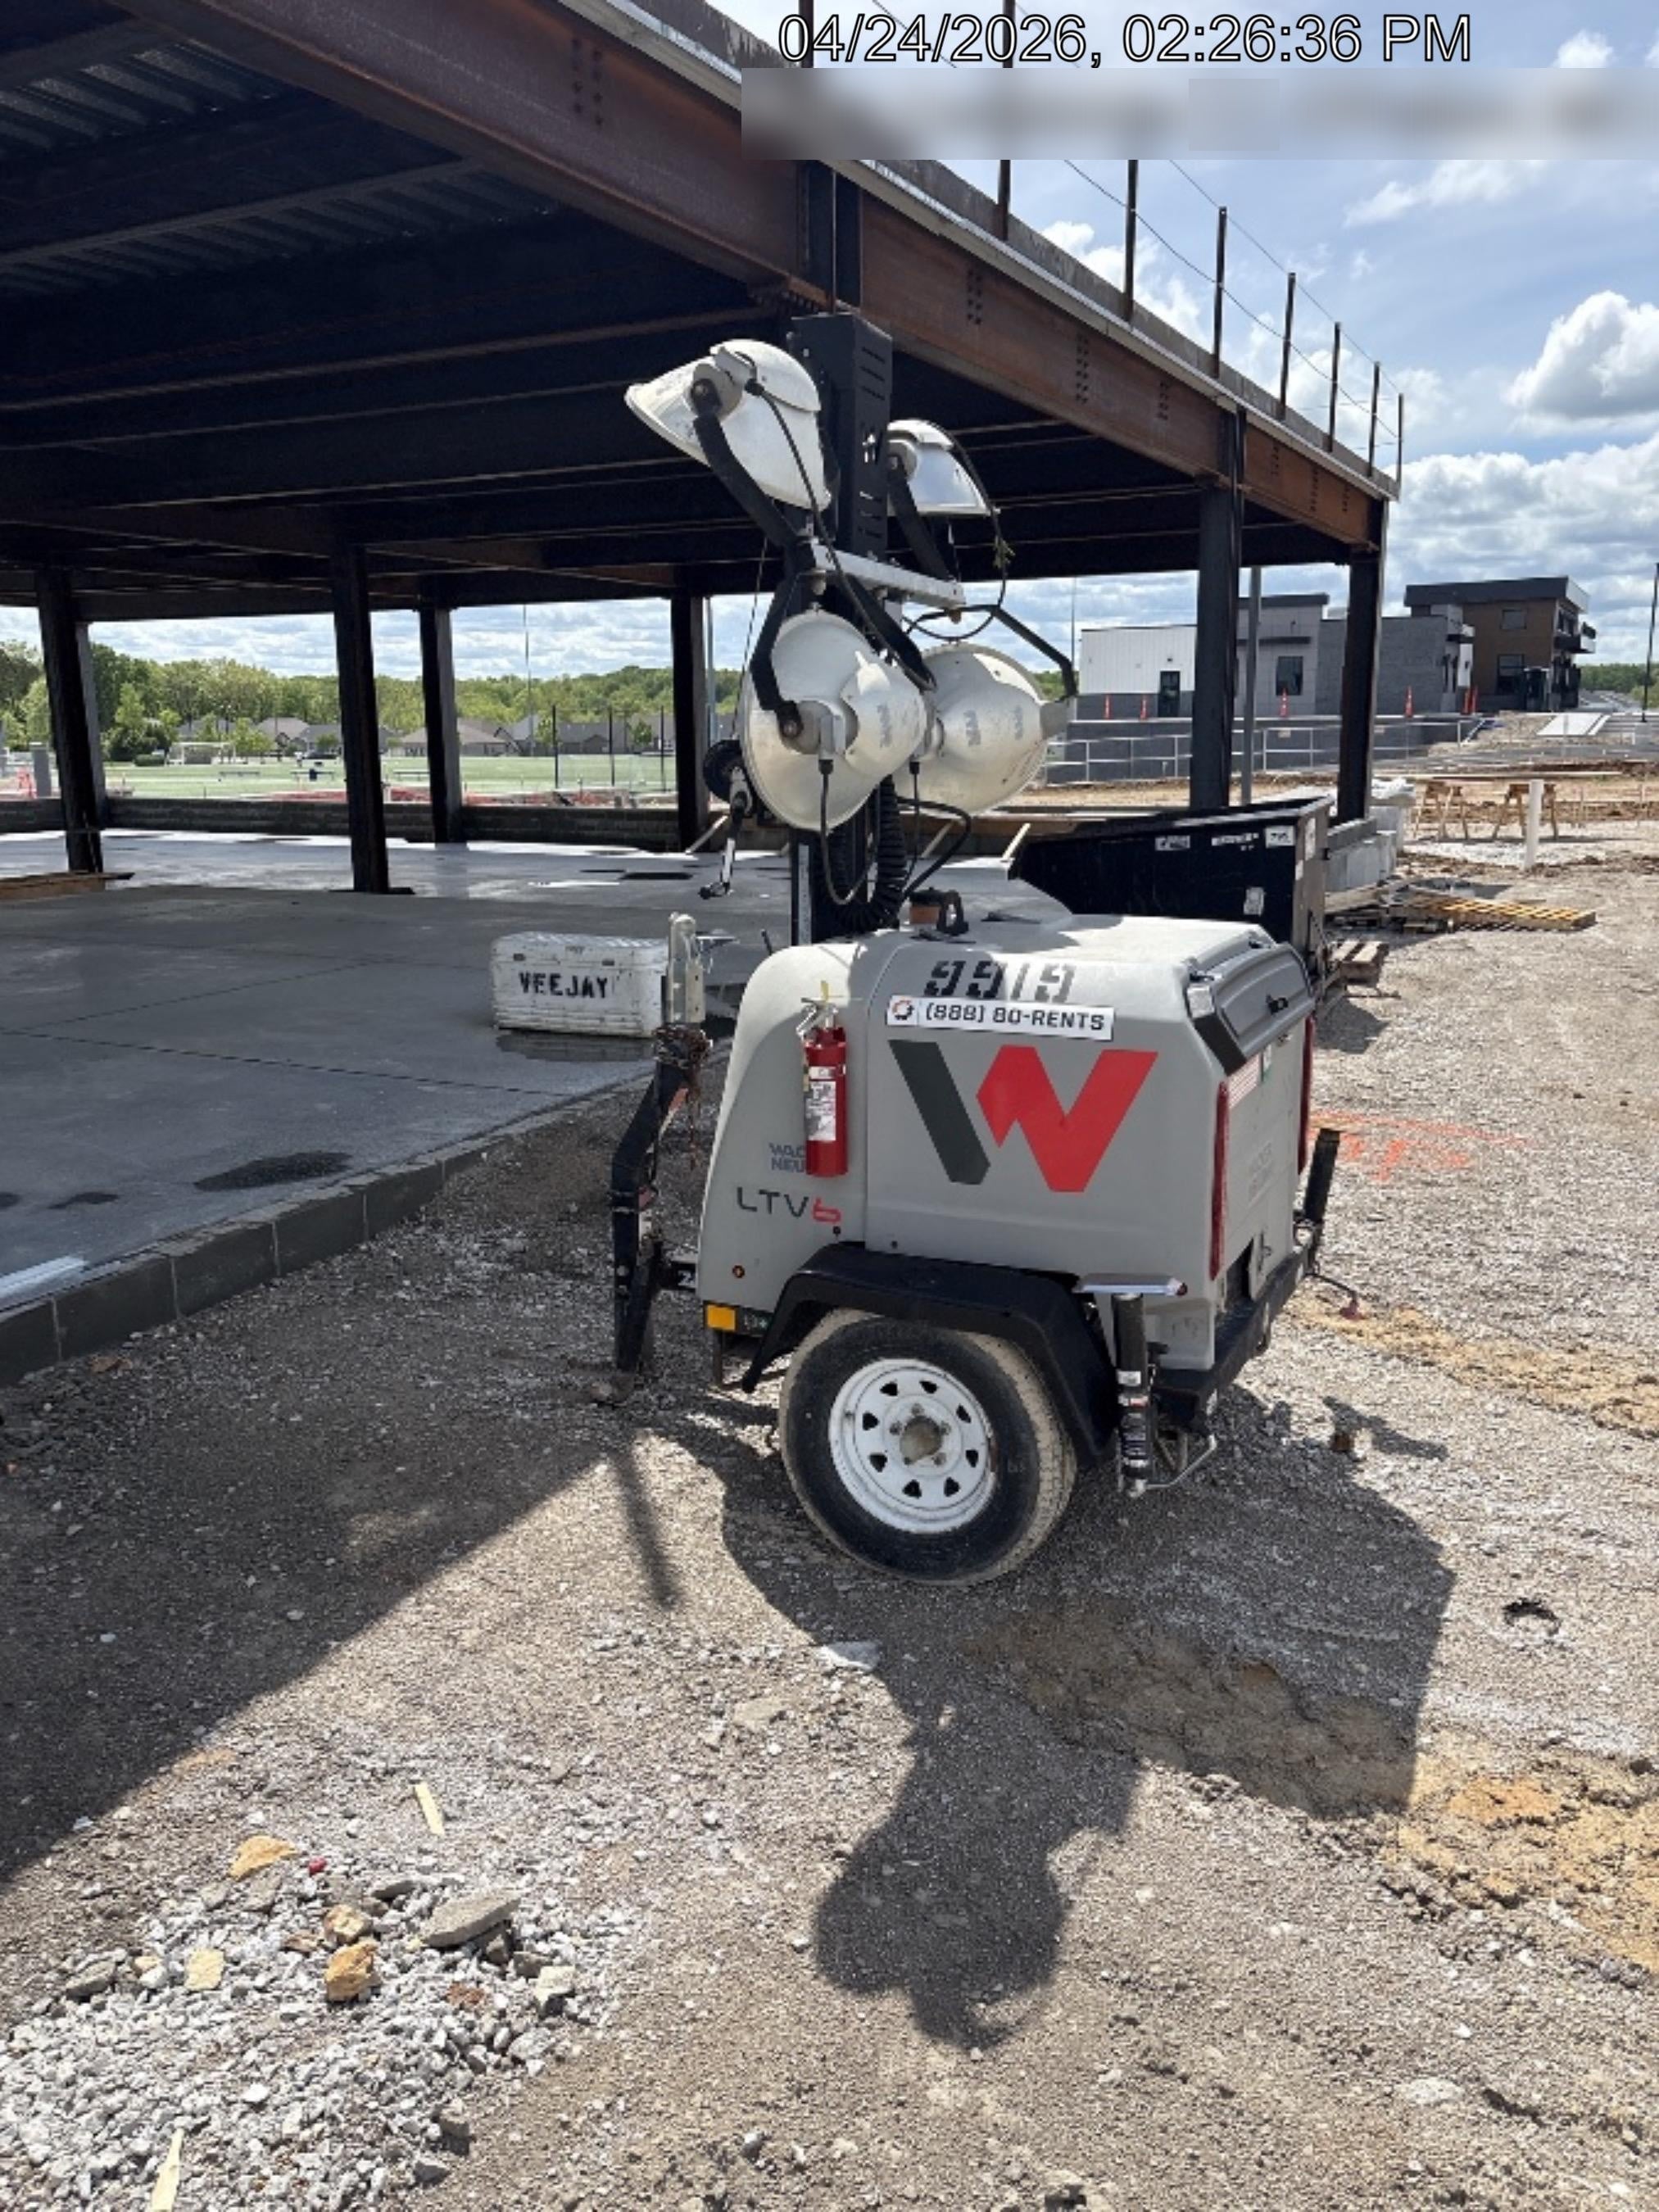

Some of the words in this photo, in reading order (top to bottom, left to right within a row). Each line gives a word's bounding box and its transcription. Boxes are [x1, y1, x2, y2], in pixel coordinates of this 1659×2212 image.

[519, 972, 608, 999] VEEJAY
[923, 960, 1077, 1003] 9919
[926, 1002, 984, 1023] (888)
[992, 1007, 1105, 1031] 80-RENTS
[768, 1141, 805, 1158] WAC
[771, 1157, 805, 1173] NEU
